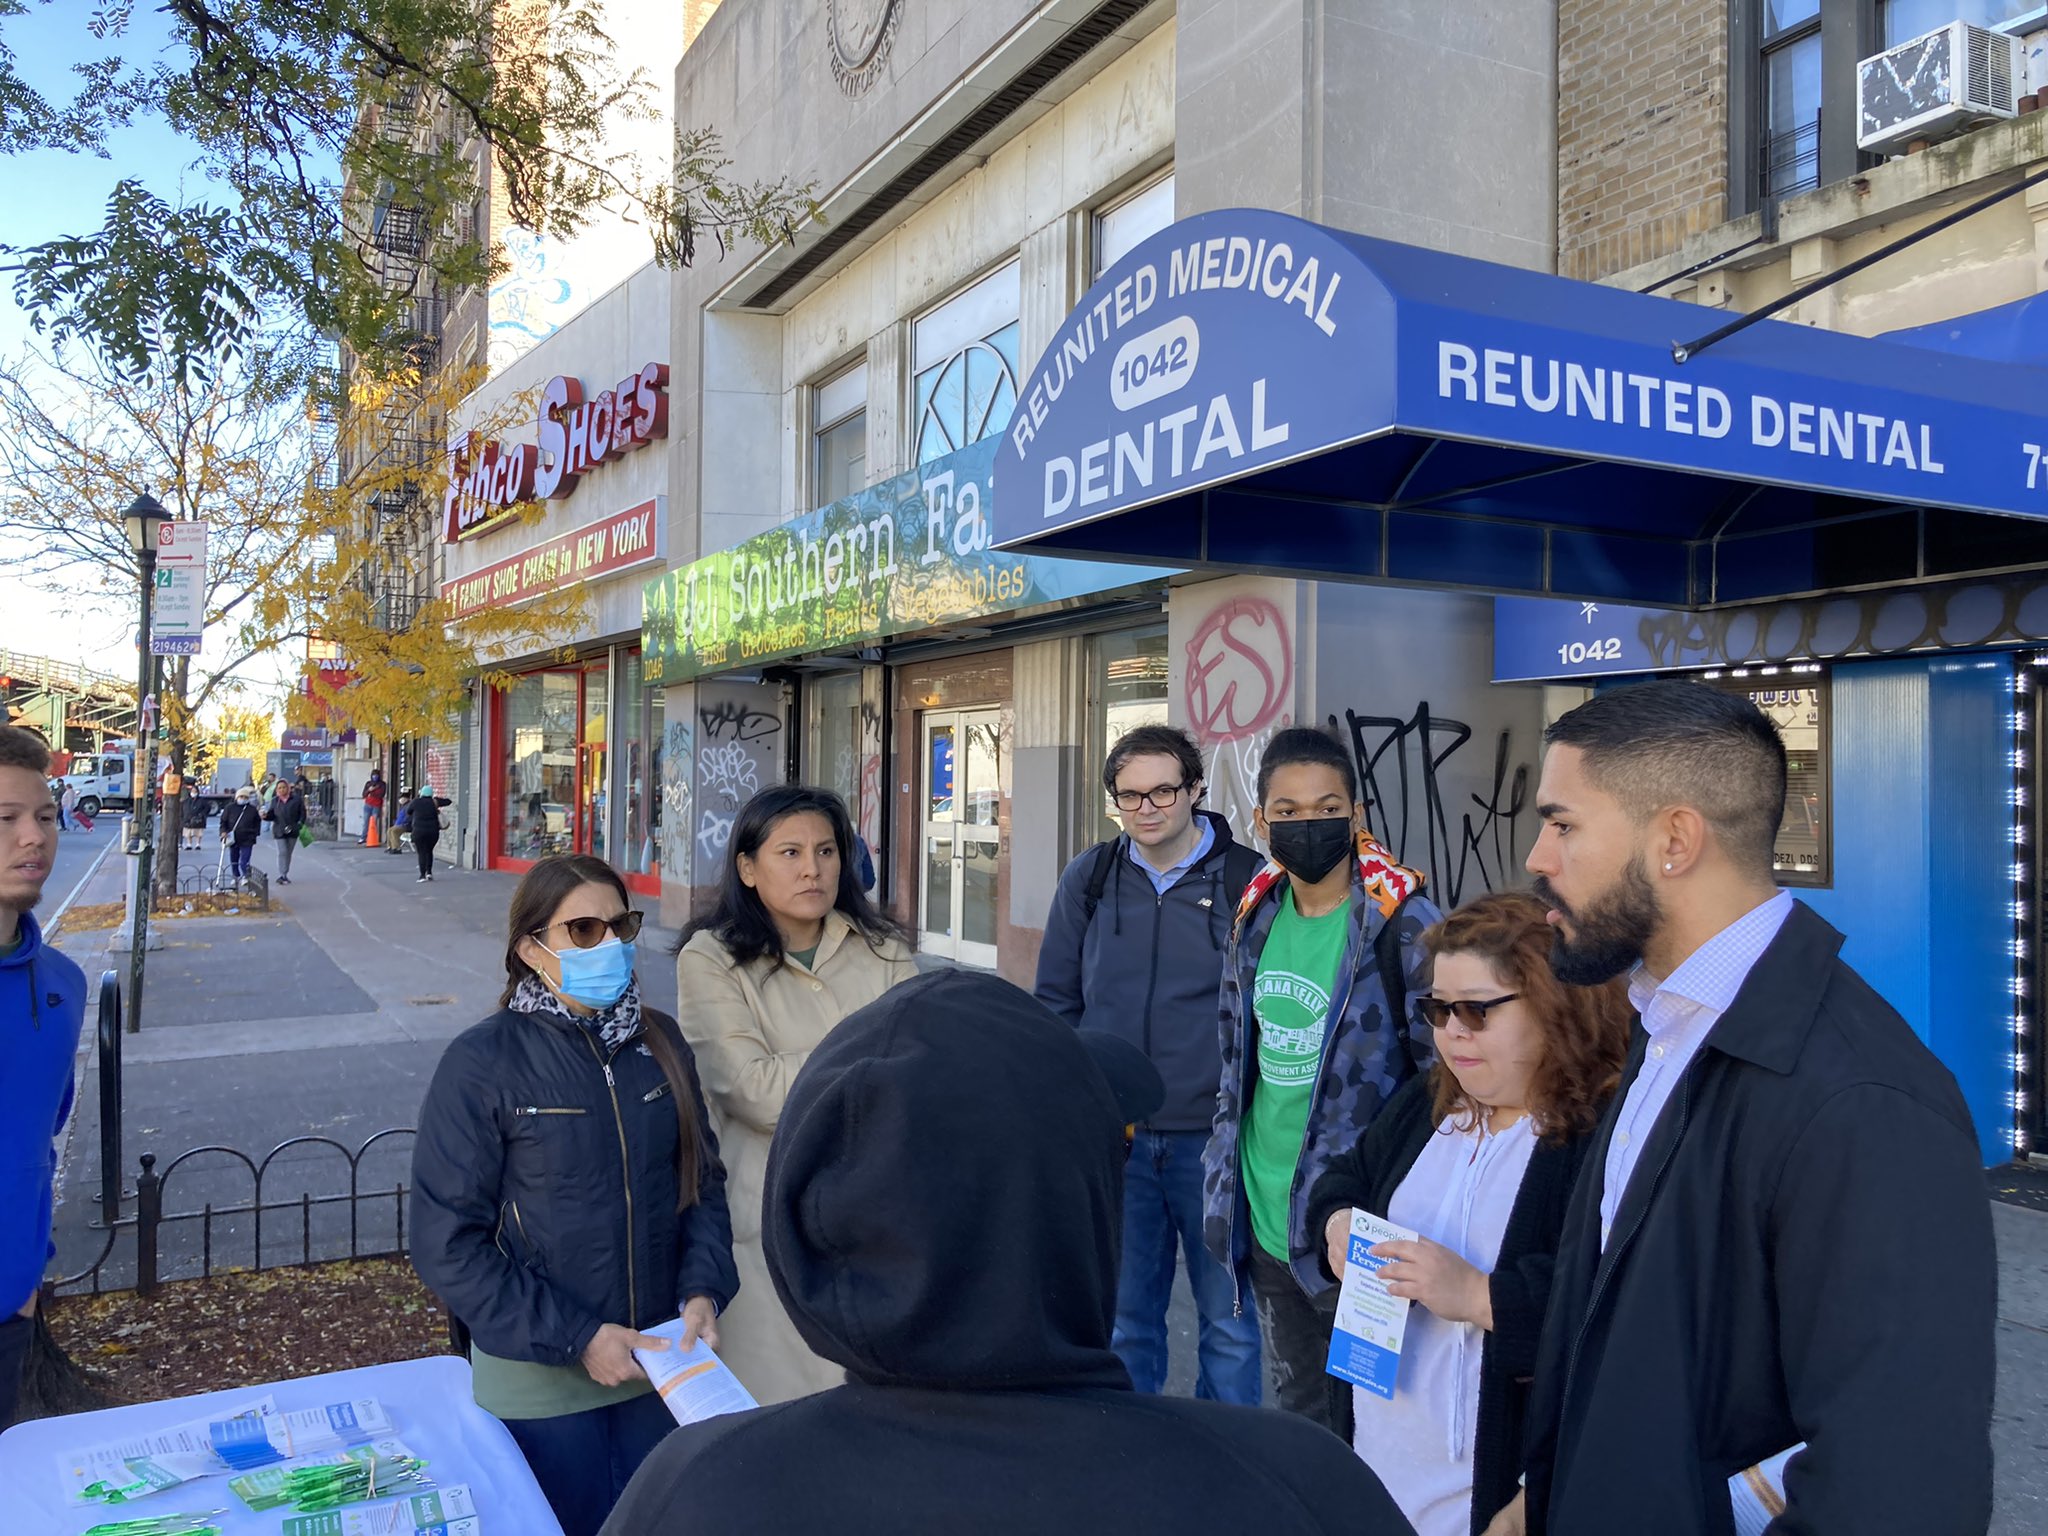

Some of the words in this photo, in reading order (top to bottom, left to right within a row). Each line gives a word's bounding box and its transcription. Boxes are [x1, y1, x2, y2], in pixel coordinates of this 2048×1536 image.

[1011, 263, 1157, 461] REUNITED
[1168, 236, 1342, 338] MEDICAL
[1119, 335, 1188, 394] 1042
[1043, 377, 1289, 519] DENTAL
[1438, 340, 1732, 439] REUNITED
[1751, 394, 1944, 474] DENTAL
[160, 569, 169, 586] 2
[459, 574, 491, 611] FAMILY
[492, 563, 519, 599] SHOE
[522, 547, 558, 591] CHAIN
[560, 546, 572, 577] in
[575, 526, 607, 571] NEW
[611, 511, 652, 558] YORK
[730, 513, 898, 624] Southern
[921, 469, 993, 566] Fa
[740, 622, 806, 658] Groceries
[823, 602, 879, 640] Fruits
[902, 564, 1024, 624] Vegetables
[1558, 637, 1622, 665] 1042
[644, 657, 663, 681] 1046
[1351, 1250, 1382, 1271] Perso
